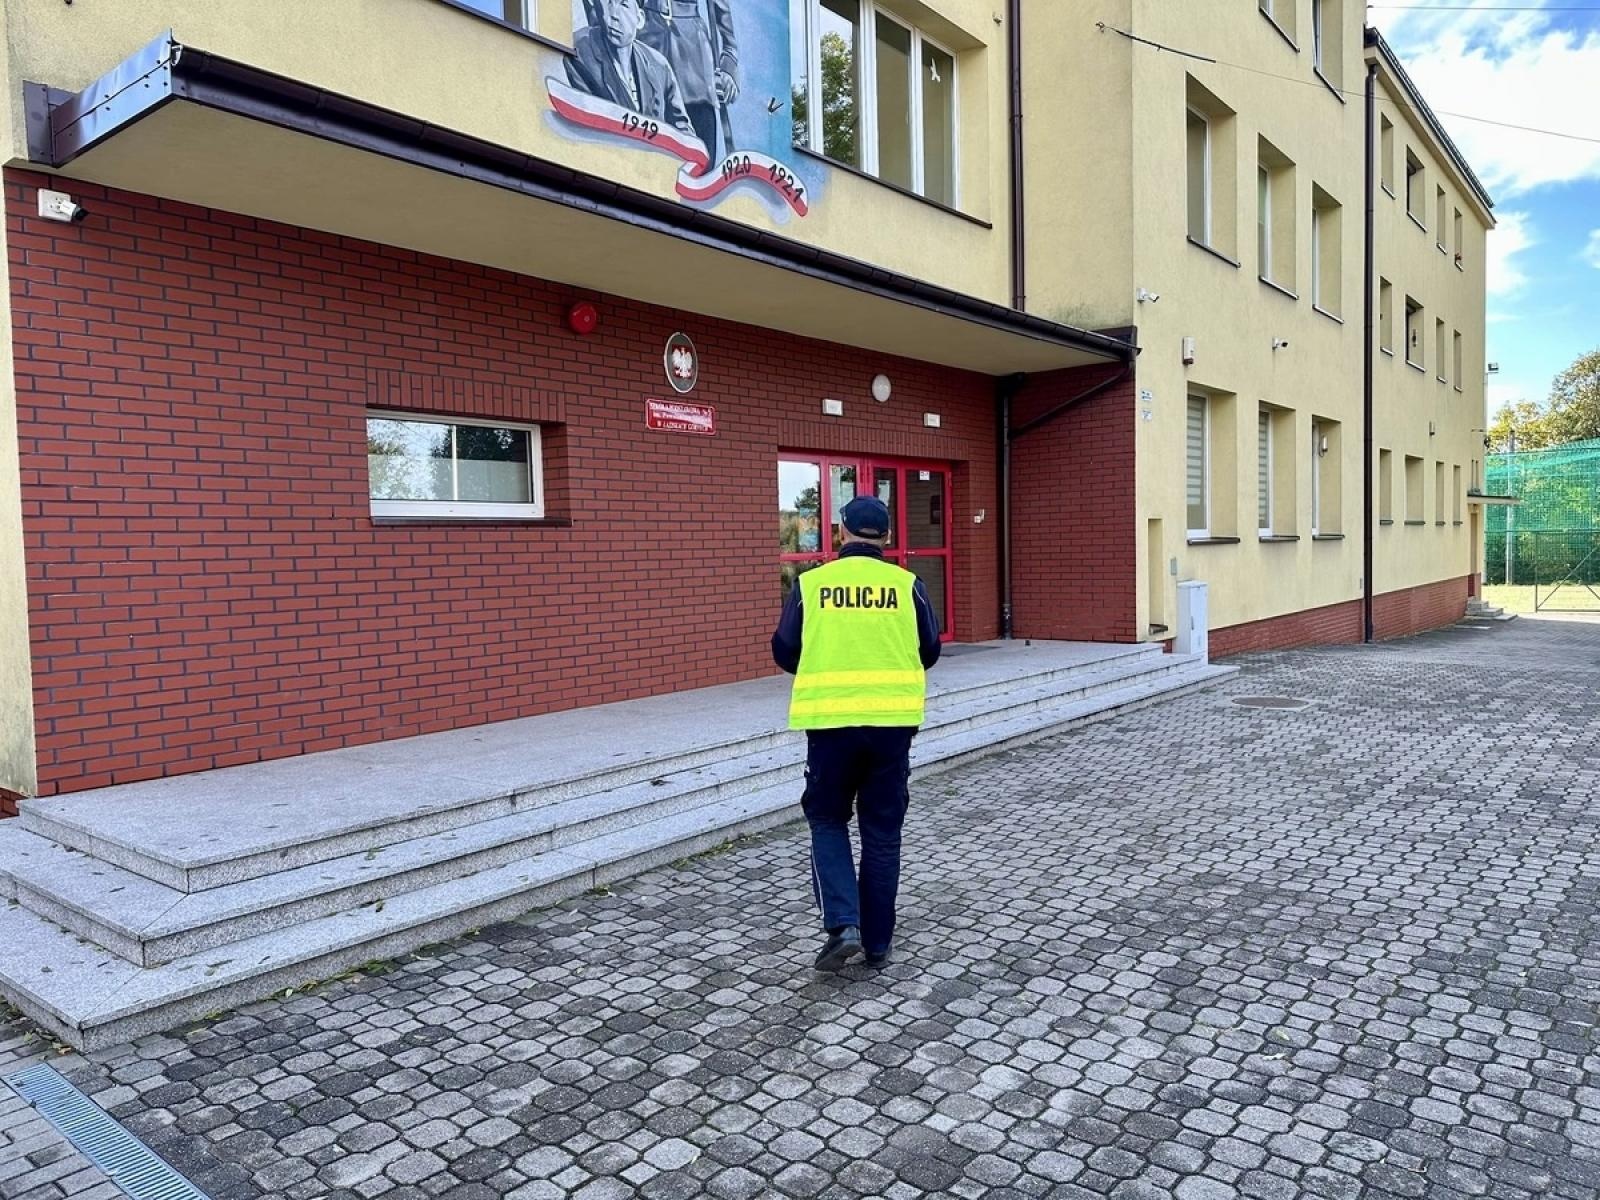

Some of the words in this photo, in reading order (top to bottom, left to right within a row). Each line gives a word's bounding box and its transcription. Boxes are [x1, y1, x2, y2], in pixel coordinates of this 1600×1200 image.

[622, 112, 659, 140] 1919
[721, 155, 752, 182] 1920
[768, 163, 804, 203] 1921
[819, 586, 898, 609] POLICJA
